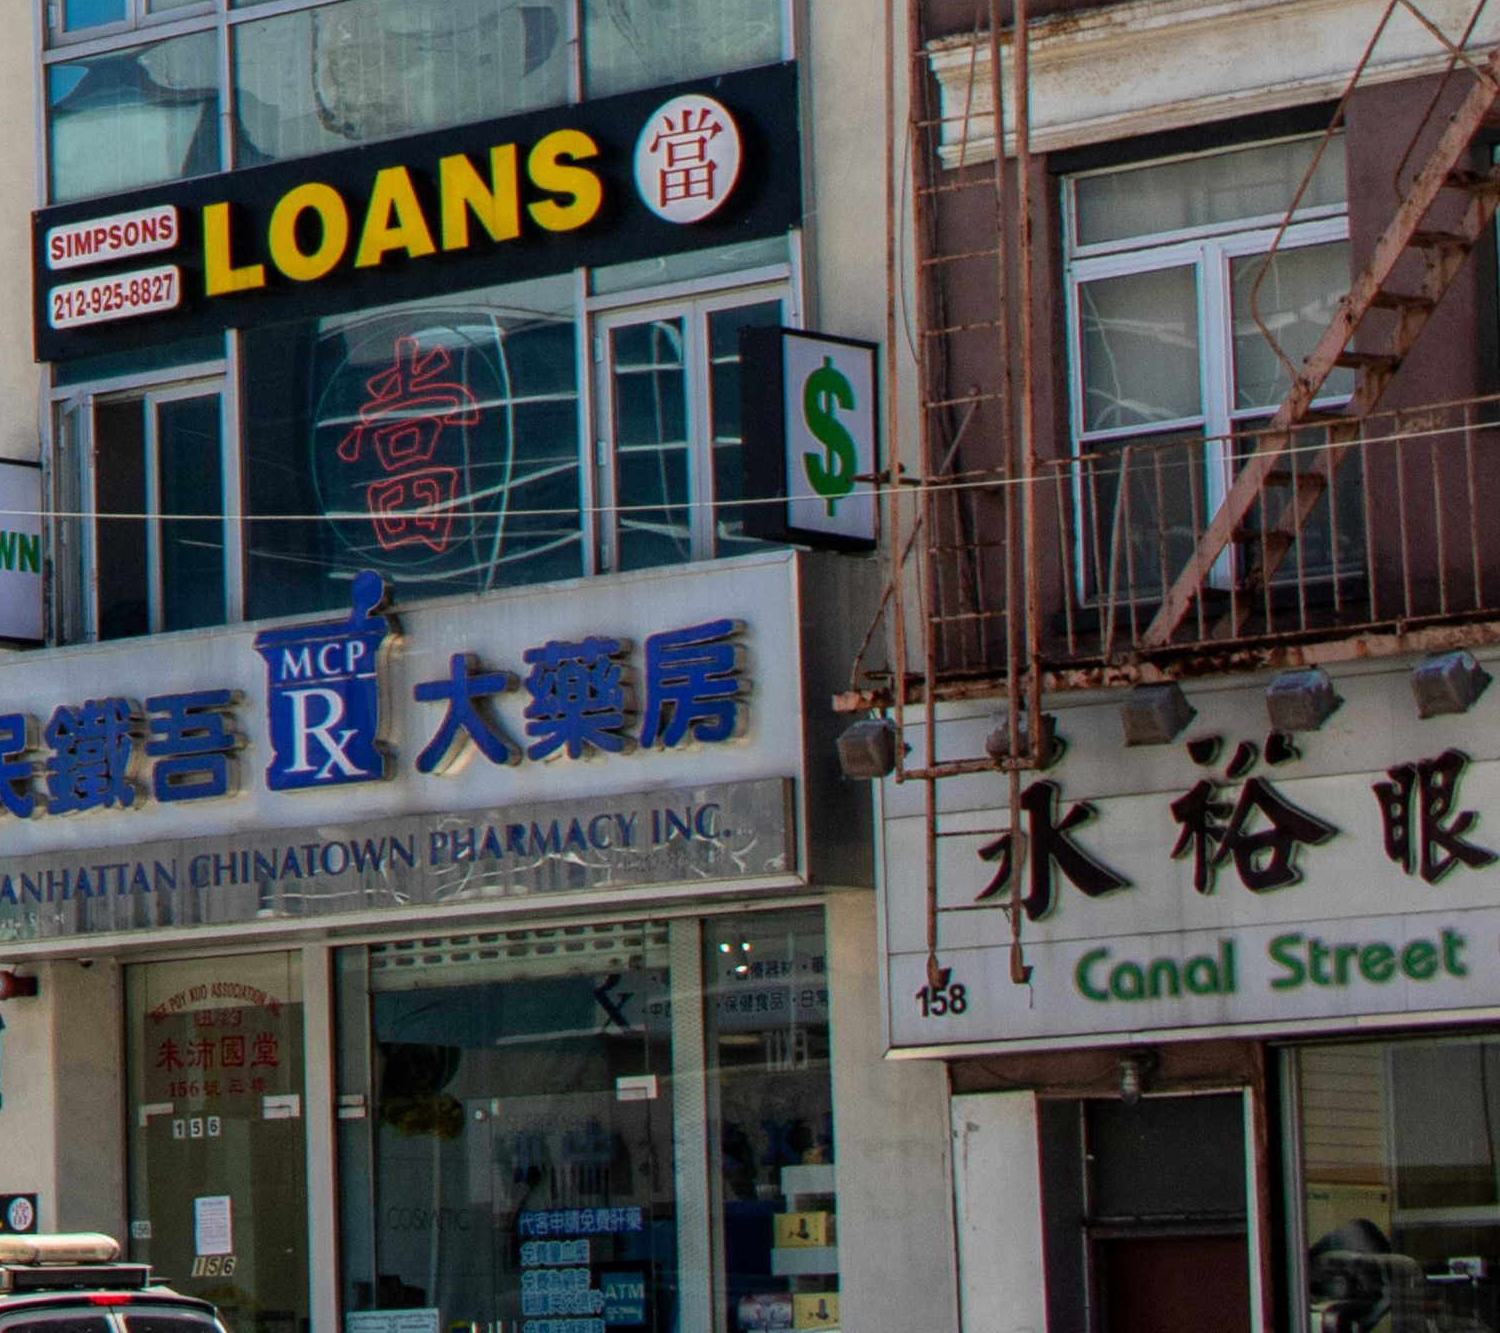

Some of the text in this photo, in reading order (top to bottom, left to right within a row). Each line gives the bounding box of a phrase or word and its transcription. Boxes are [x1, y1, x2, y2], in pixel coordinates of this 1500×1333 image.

[203, 107, 724, 297] LOANS 當
[49, 212, 174, 262] SIMPSONS
[53, 271, 175, 322] 212-925-8827
[279, 640, 366, 681] MCP
[189, 835, 416, 891] CHINATOWN
[428, 812, 638, 864] PHARMACY
[650, 803, 734, 845] INC.
[1074, 927, 1470, 1005] Canal Street
[915, 983, 968, 1019] 158
[175, 1118, 218, 1137] 156
[194, 1257, 236, 1276] 156
[605, 1284, 645, 1300] ATM
